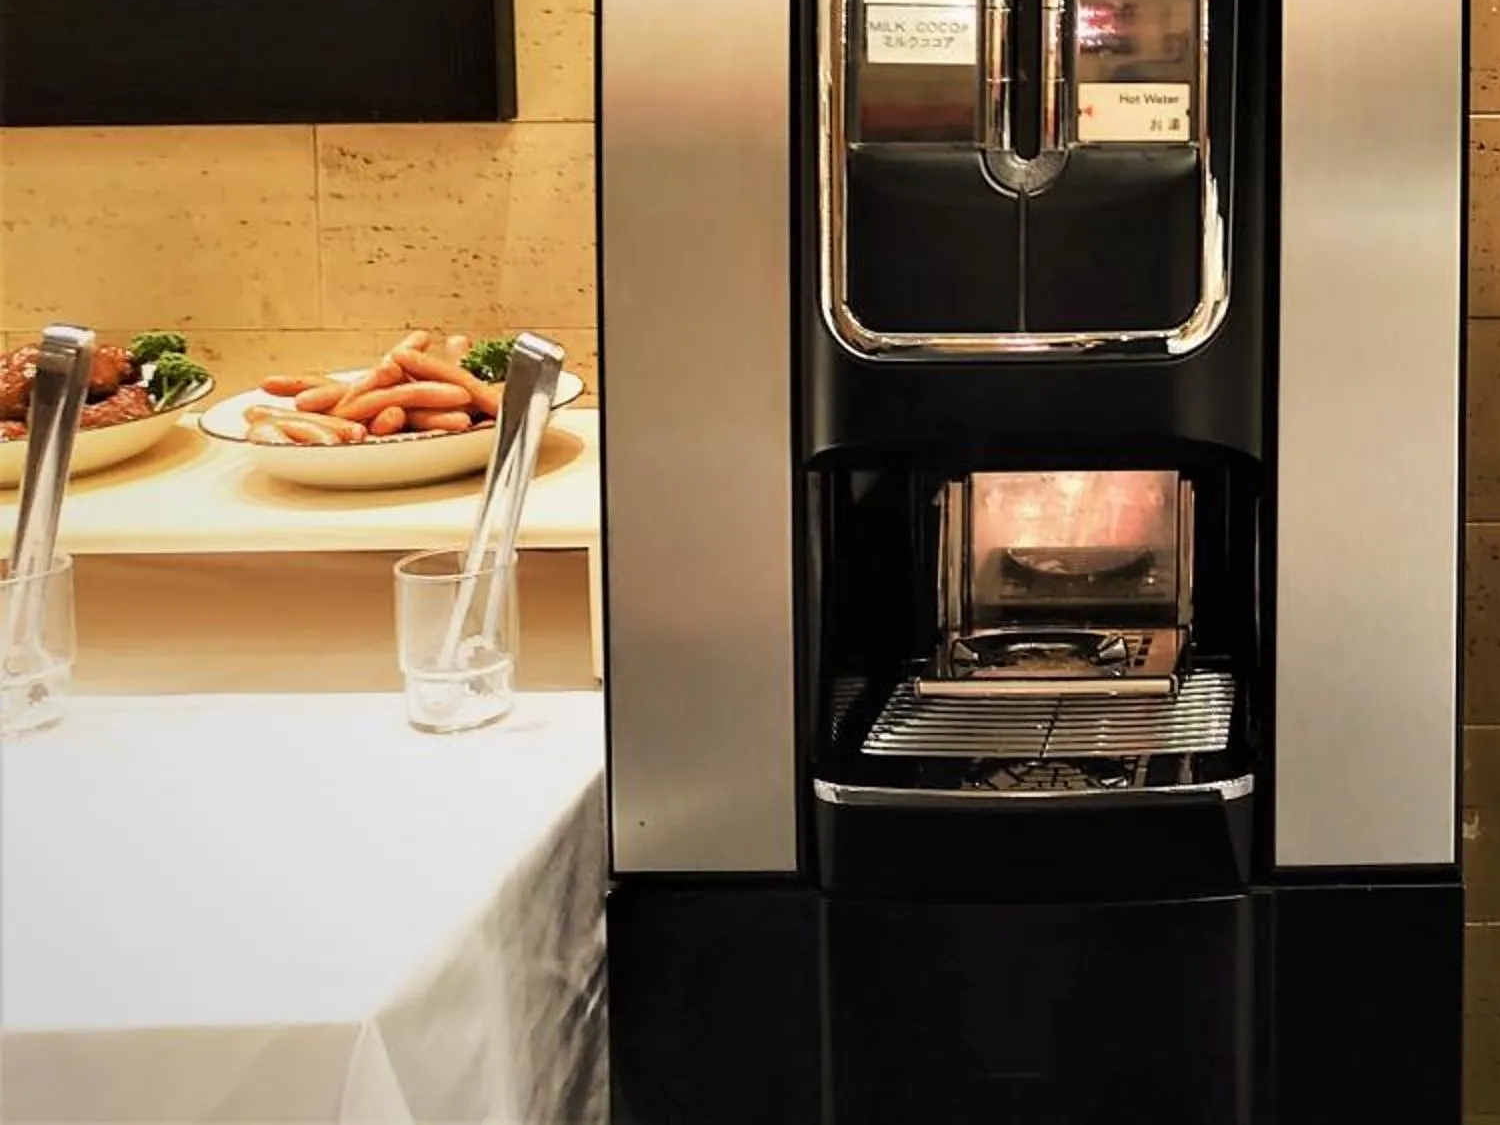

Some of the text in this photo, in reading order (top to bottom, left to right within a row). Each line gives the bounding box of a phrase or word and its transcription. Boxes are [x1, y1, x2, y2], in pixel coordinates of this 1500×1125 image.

[869, 21, 905, 33] MILK
[883, 35, 956, 50] ミルクココア
[1119, 93, 1180, 105] Hot Water
